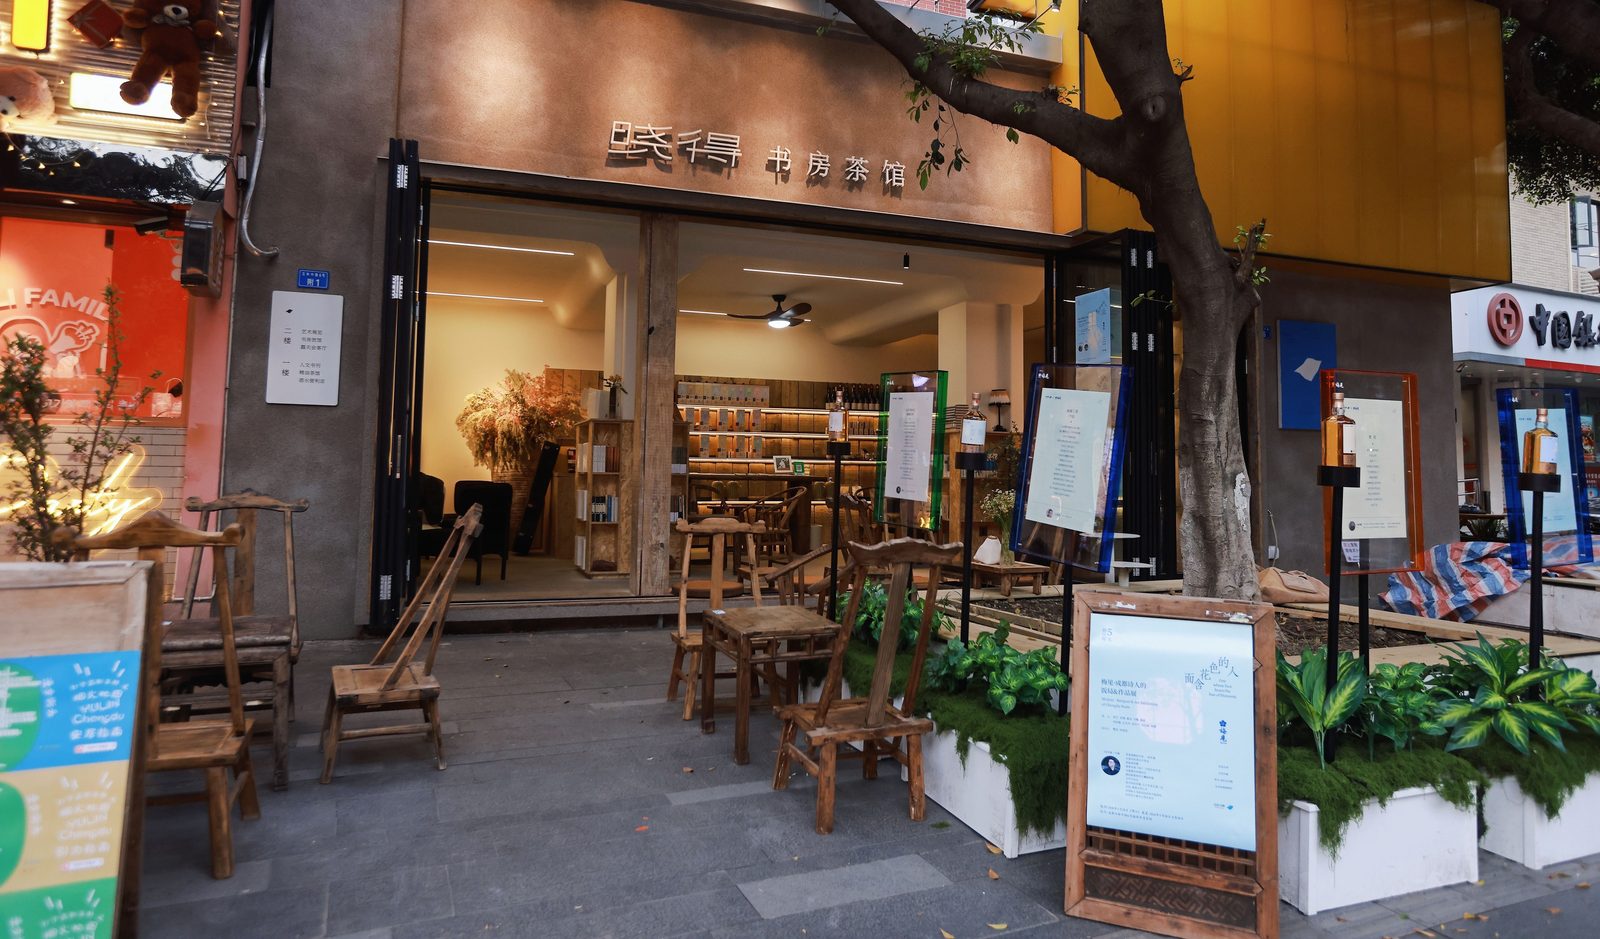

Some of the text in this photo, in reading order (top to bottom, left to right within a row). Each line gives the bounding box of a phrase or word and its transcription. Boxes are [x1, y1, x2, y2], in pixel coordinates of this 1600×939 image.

[767, 145, 906, 187] 书房茶馆
[1528, 304, 1600, 350] 中国银
